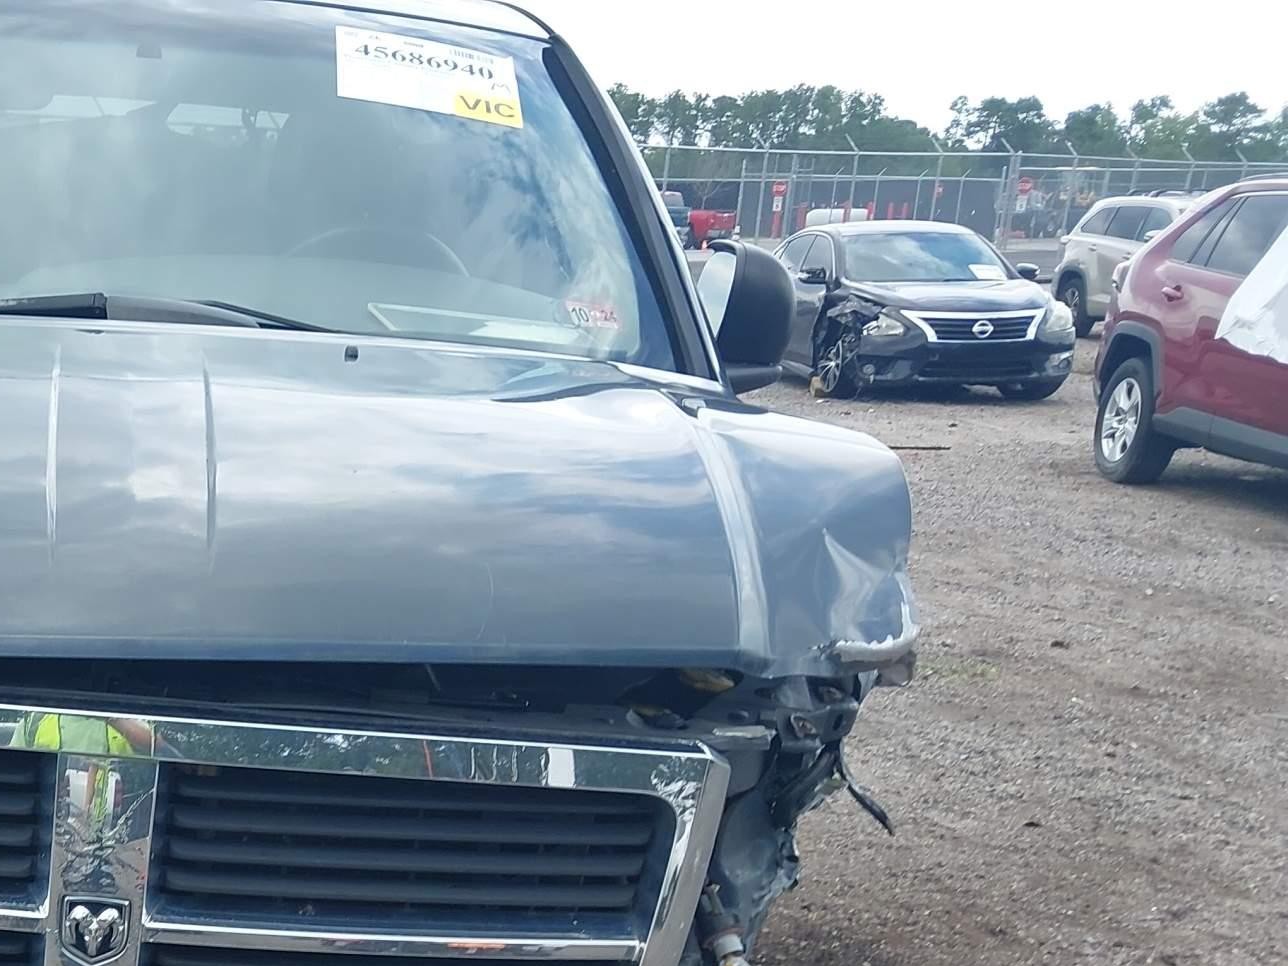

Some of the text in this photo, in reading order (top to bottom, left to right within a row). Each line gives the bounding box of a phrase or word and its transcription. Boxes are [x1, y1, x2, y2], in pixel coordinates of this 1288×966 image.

[354, 43, 494, 80] 45686940
[459, 94, 516, 118] VIC
[571, 307, 590, 323] 10
